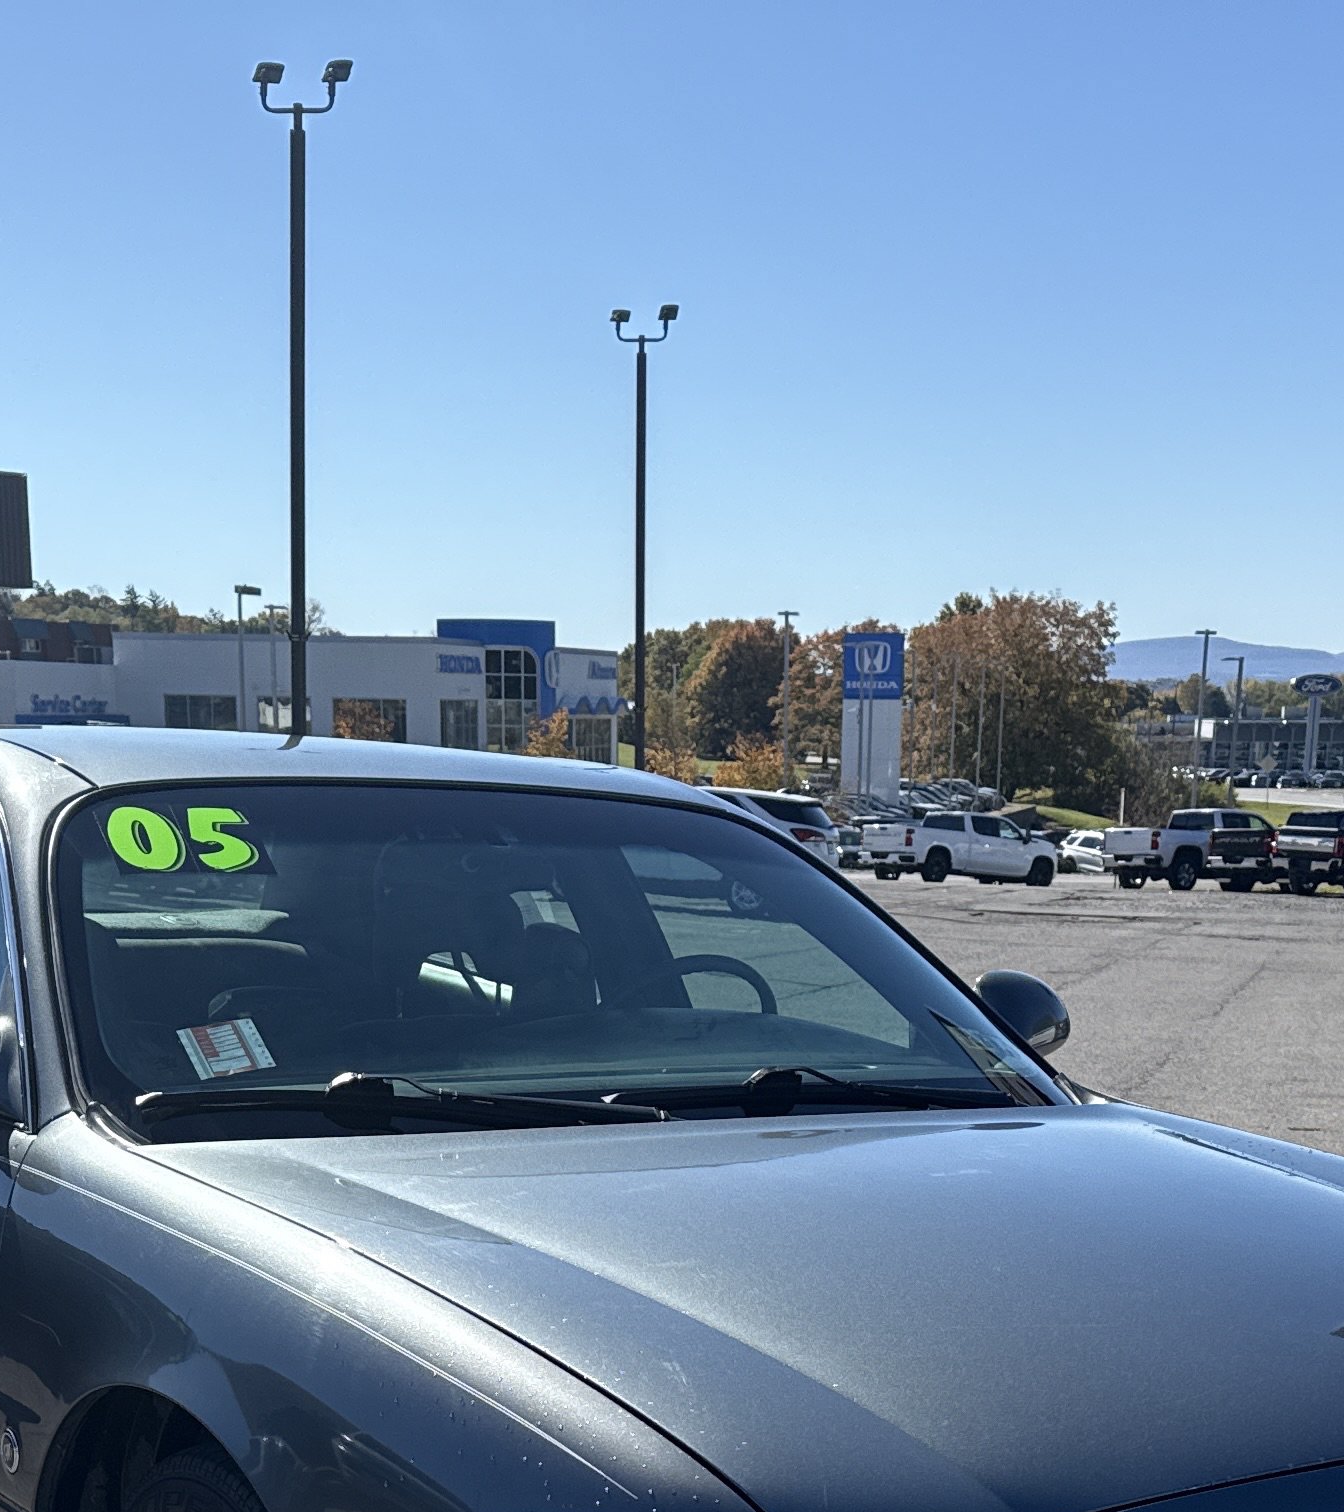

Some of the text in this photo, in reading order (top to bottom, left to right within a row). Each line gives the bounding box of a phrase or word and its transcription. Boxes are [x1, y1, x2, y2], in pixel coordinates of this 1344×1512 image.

[439, 654, 483, 675] HONDA
[846, 680, 899, 689] HONDA
[1301, 678, 1333, 692] Ford
[107, 806, 259, 873] 05
